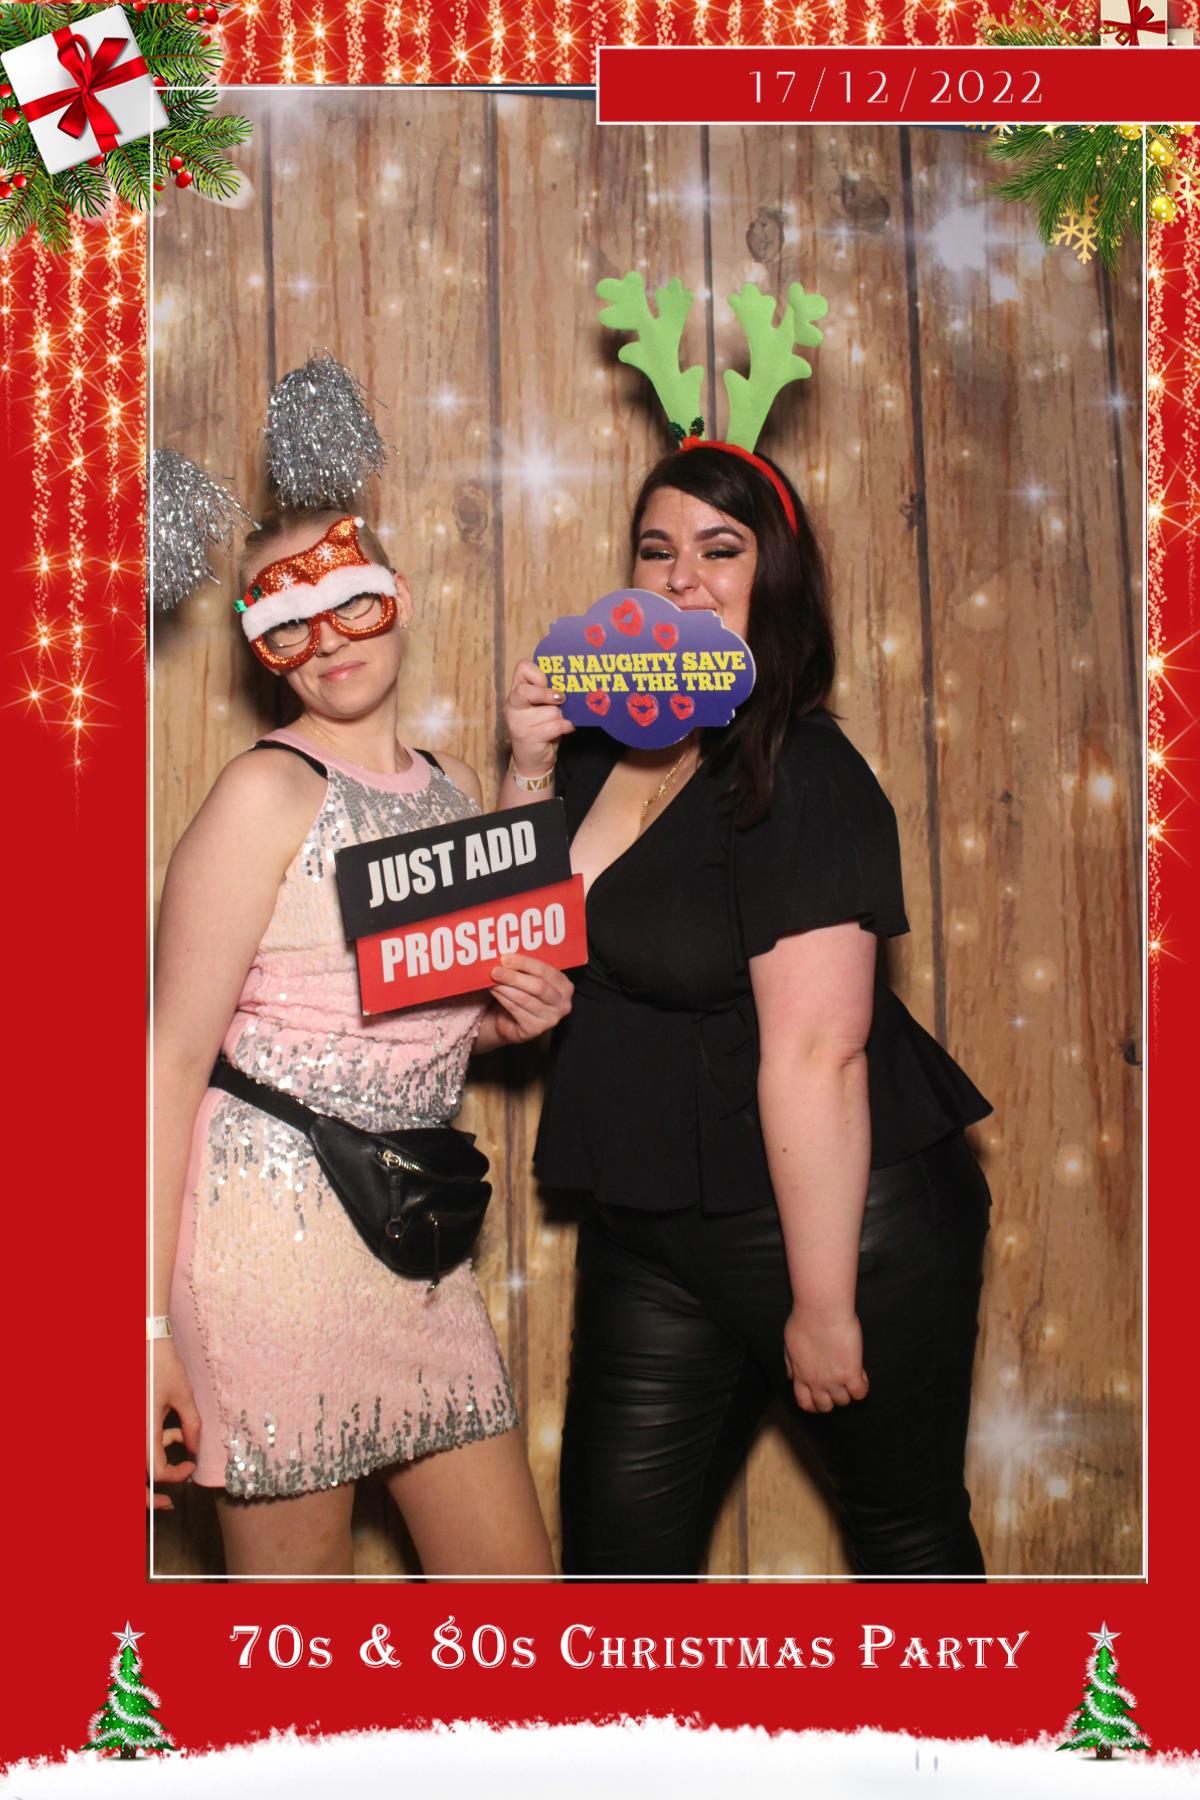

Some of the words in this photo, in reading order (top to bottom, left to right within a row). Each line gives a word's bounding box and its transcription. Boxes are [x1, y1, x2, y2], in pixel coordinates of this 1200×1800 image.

[537, 655, 566, 674] BE
[568, 652, 677, 673] NAUGHTY
[682, 651, 747, 672] SAVE
[551, 673, 629, 693] SANTA
[632, 672, 679, 692] THE
[682, 671, 737, 691] TRIP
[367, 840, 455, 909] JUST
[465, 820, 538, 880] ADD
[380, 902, 566, 983] PROSECCO
